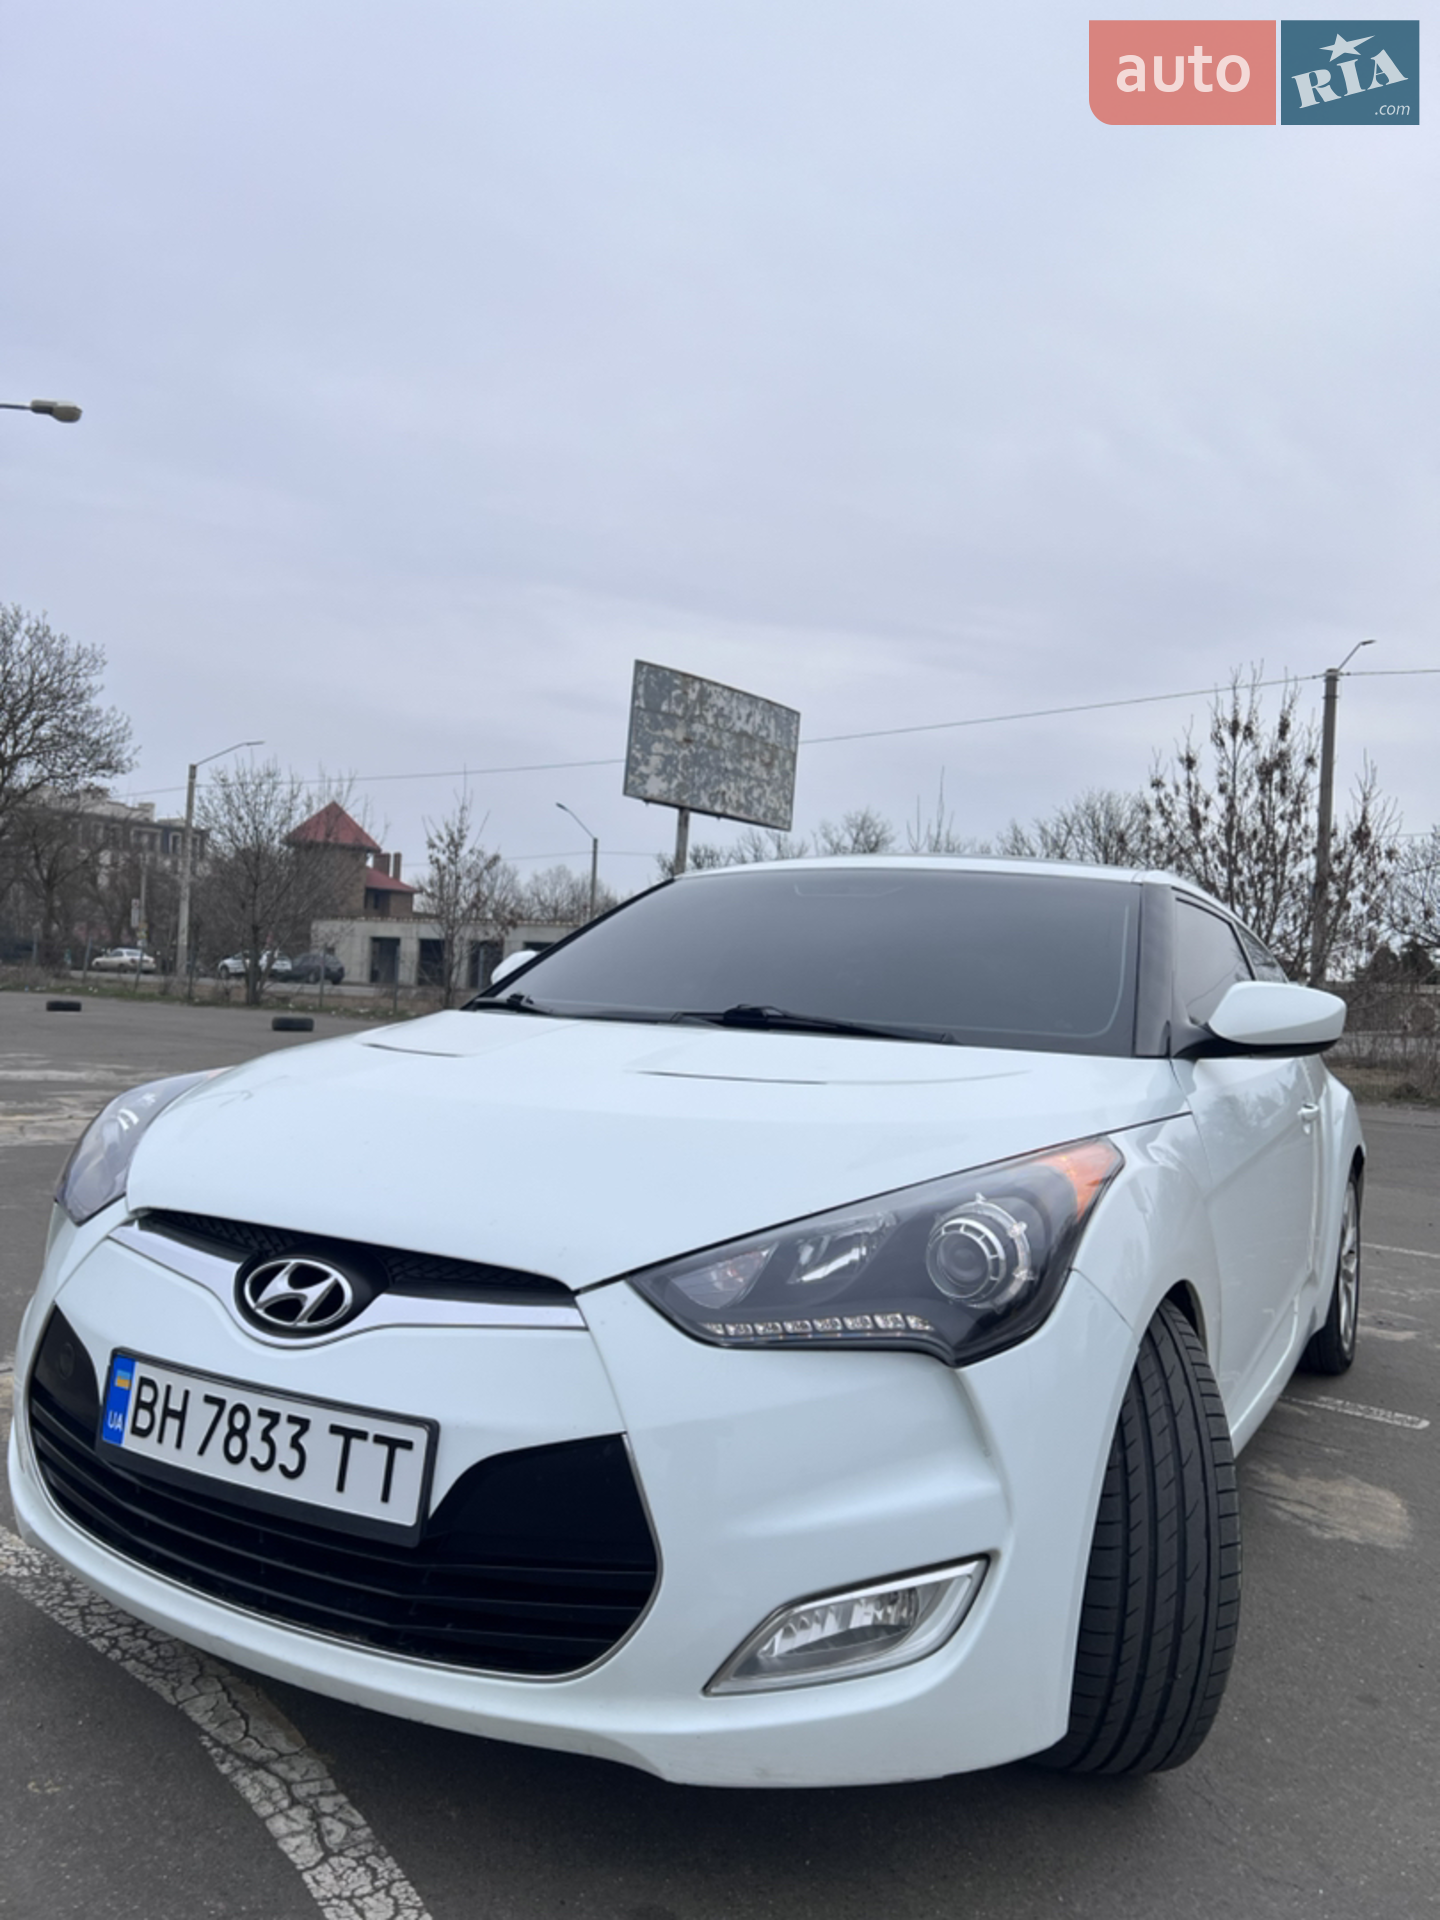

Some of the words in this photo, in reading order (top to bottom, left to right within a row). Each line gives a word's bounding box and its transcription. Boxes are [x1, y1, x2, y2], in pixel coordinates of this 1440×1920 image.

[106, 1410, 124, 1431] UA
[130, 1375, 190, 1450] BH
[197, 1393, 311, 1480] 7833
[328, 1423, 414, 1504] TT
